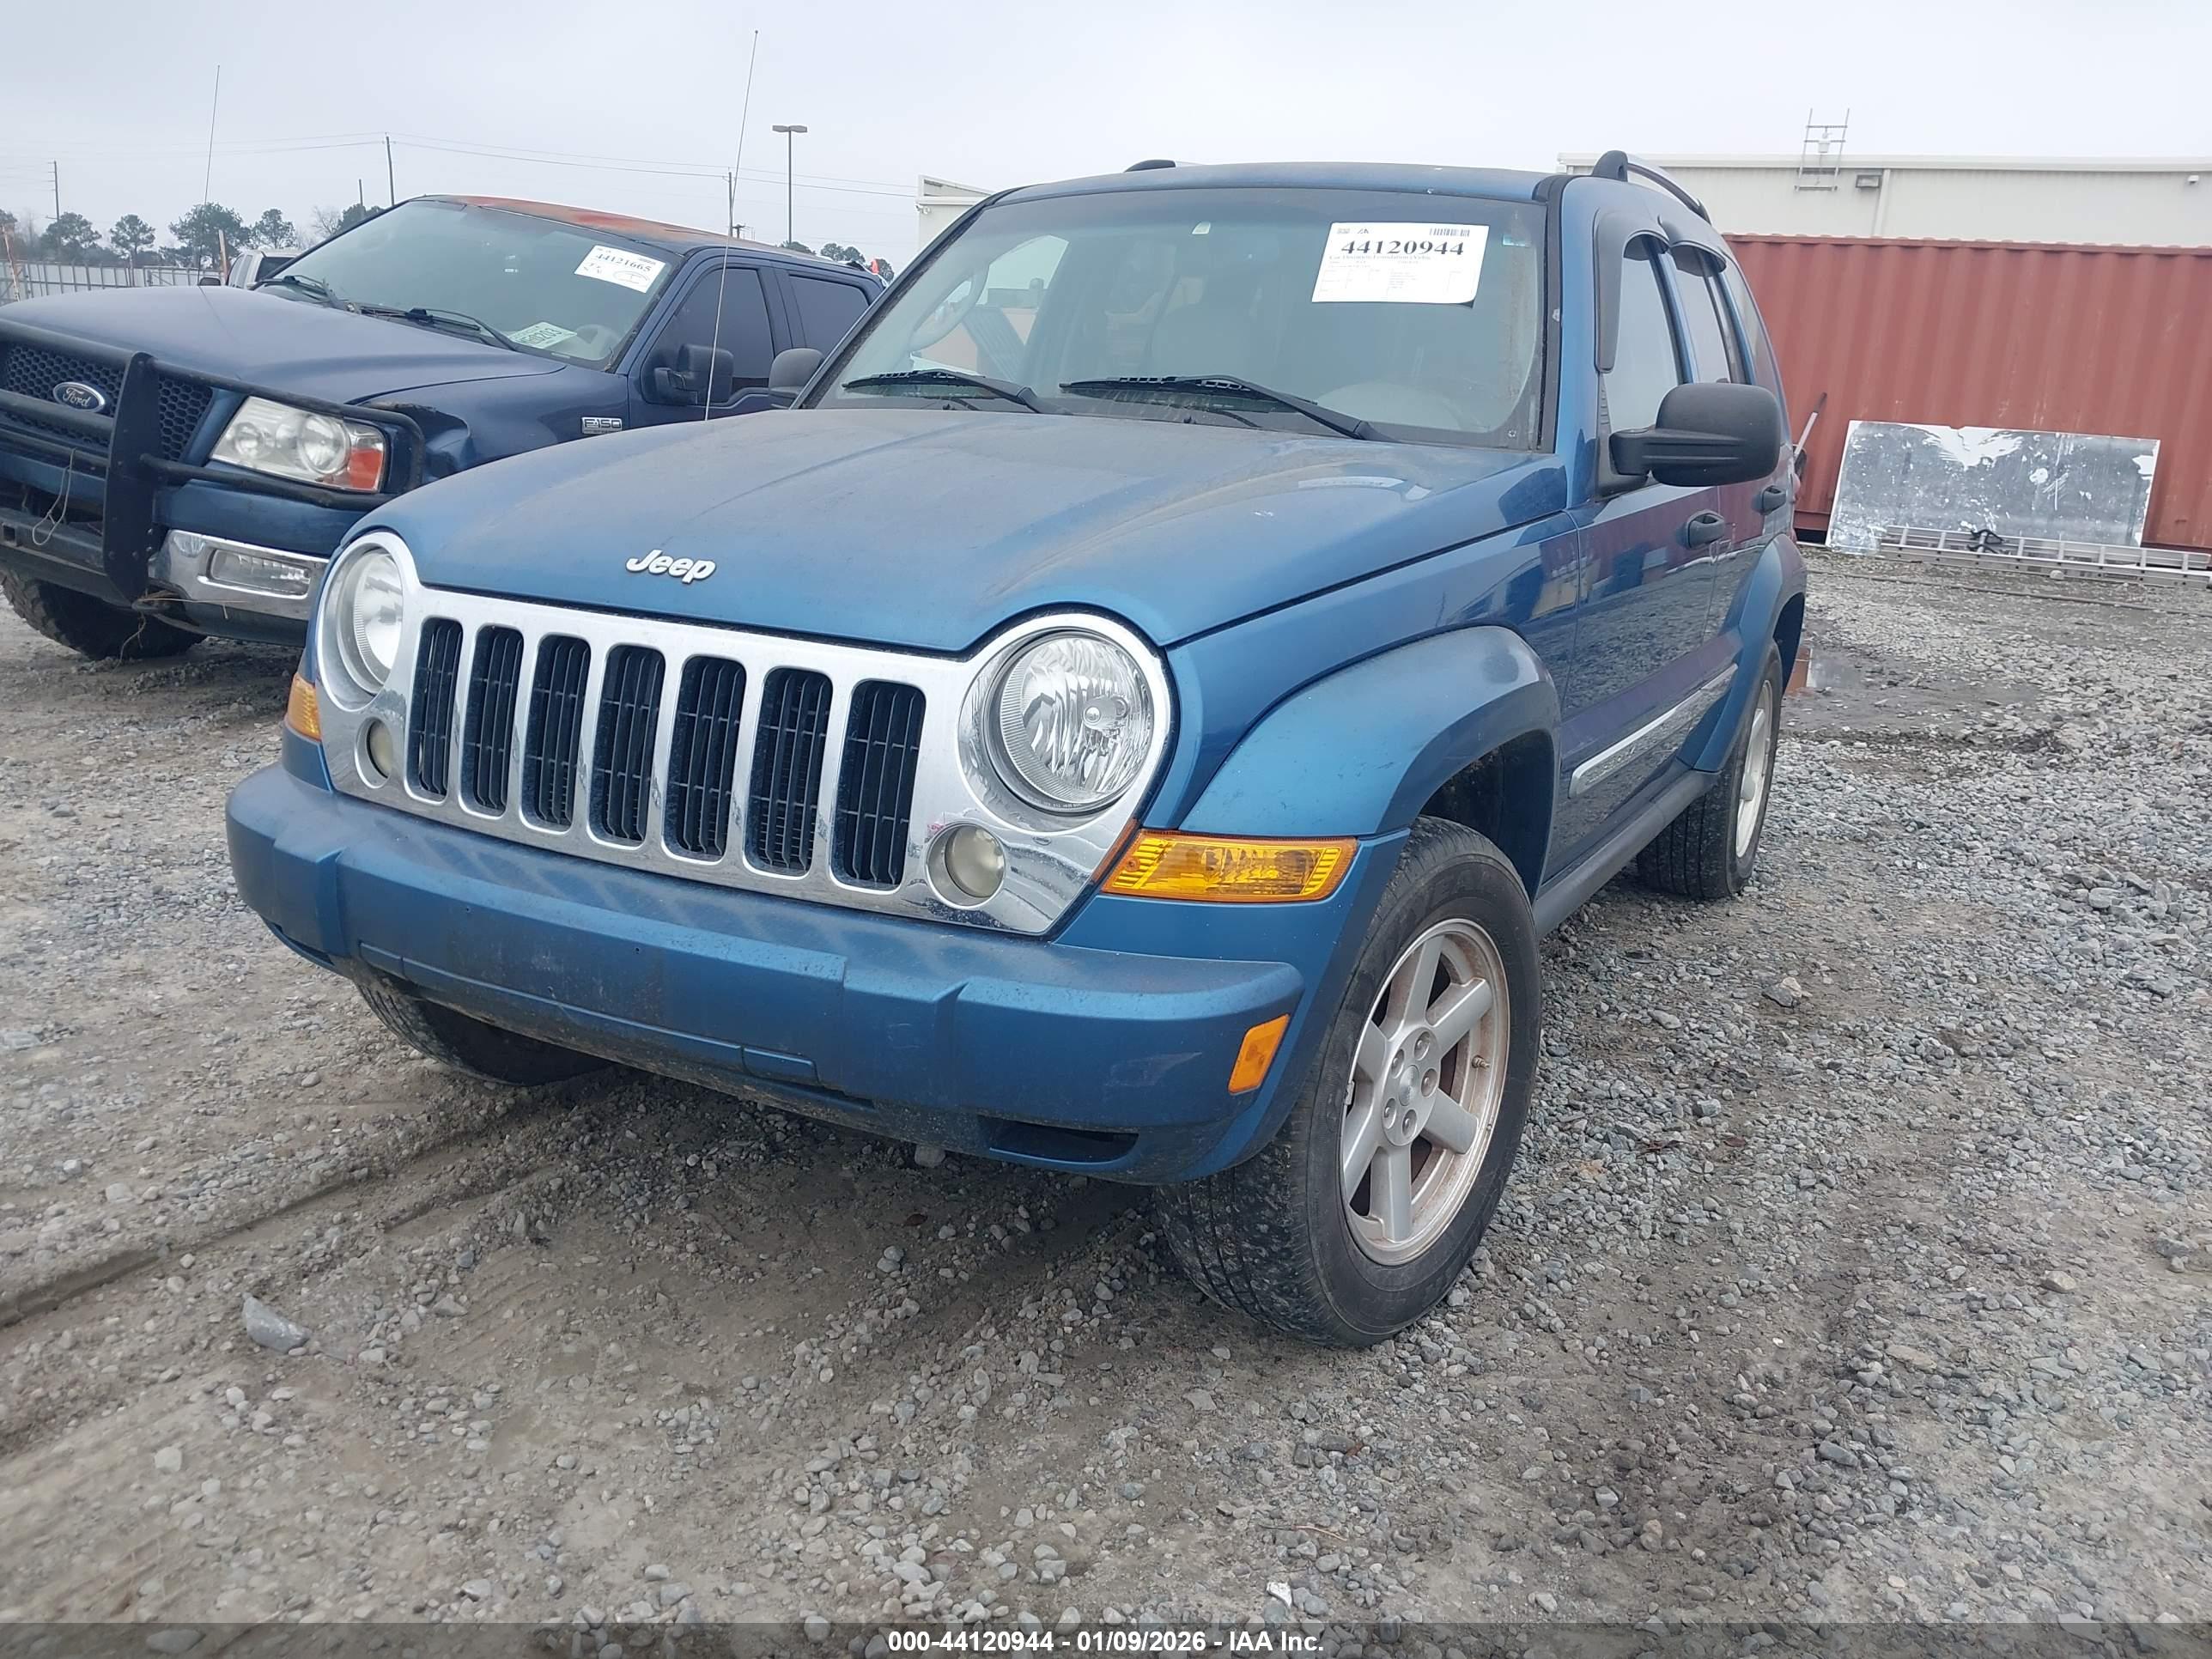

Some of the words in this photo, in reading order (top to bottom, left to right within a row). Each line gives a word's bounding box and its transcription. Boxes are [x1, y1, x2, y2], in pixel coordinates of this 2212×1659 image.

[1340, 240, 1464, 256] 44120944
[596, 253, 653, 272] 44121665
[62, 387, 92, 407] Ford
[584, 418, 622, 428] F-150
[625, 549, 716, 584] Jeep
